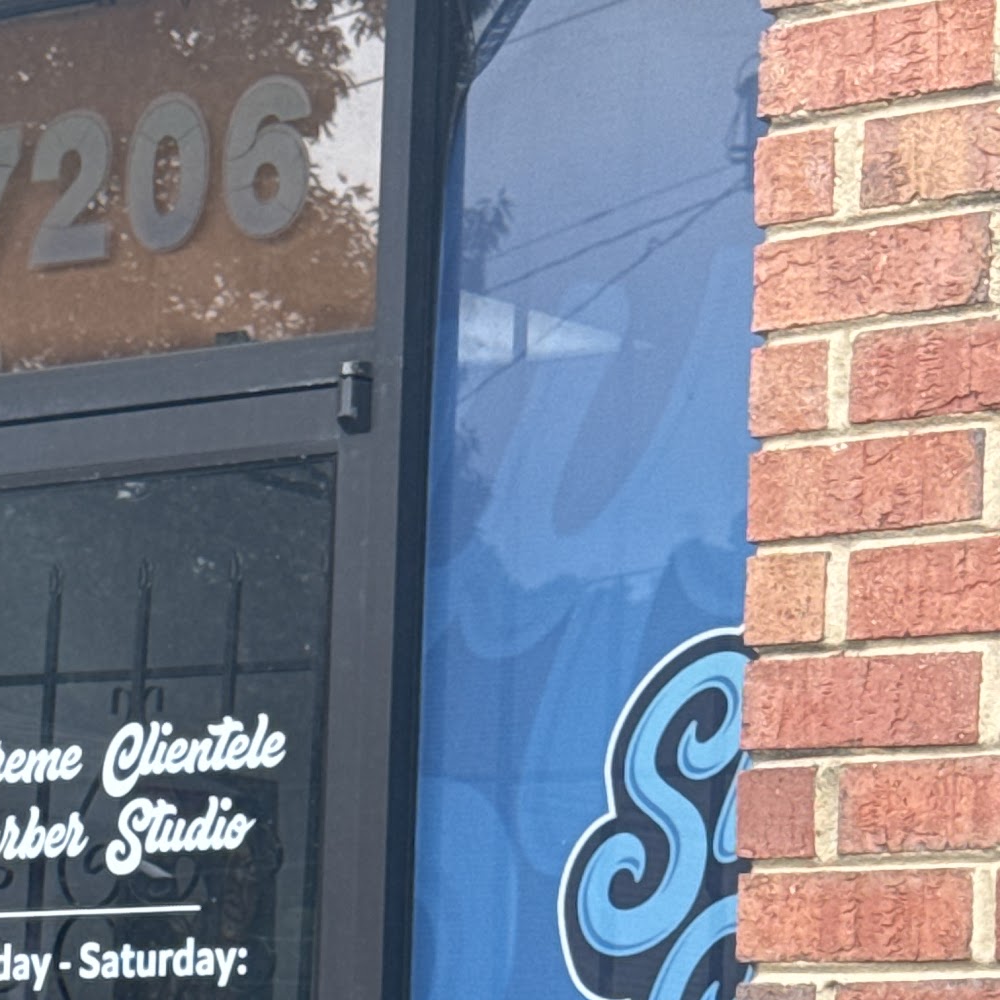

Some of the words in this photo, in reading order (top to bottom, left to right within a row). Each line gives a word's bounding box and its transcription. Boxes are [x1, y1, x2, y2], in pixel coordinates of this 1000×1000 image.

[103, 713, 287, 798] Clientele
[106, 796, 257, 876] Studio
[78, 936, 248, 988] Saturday:
